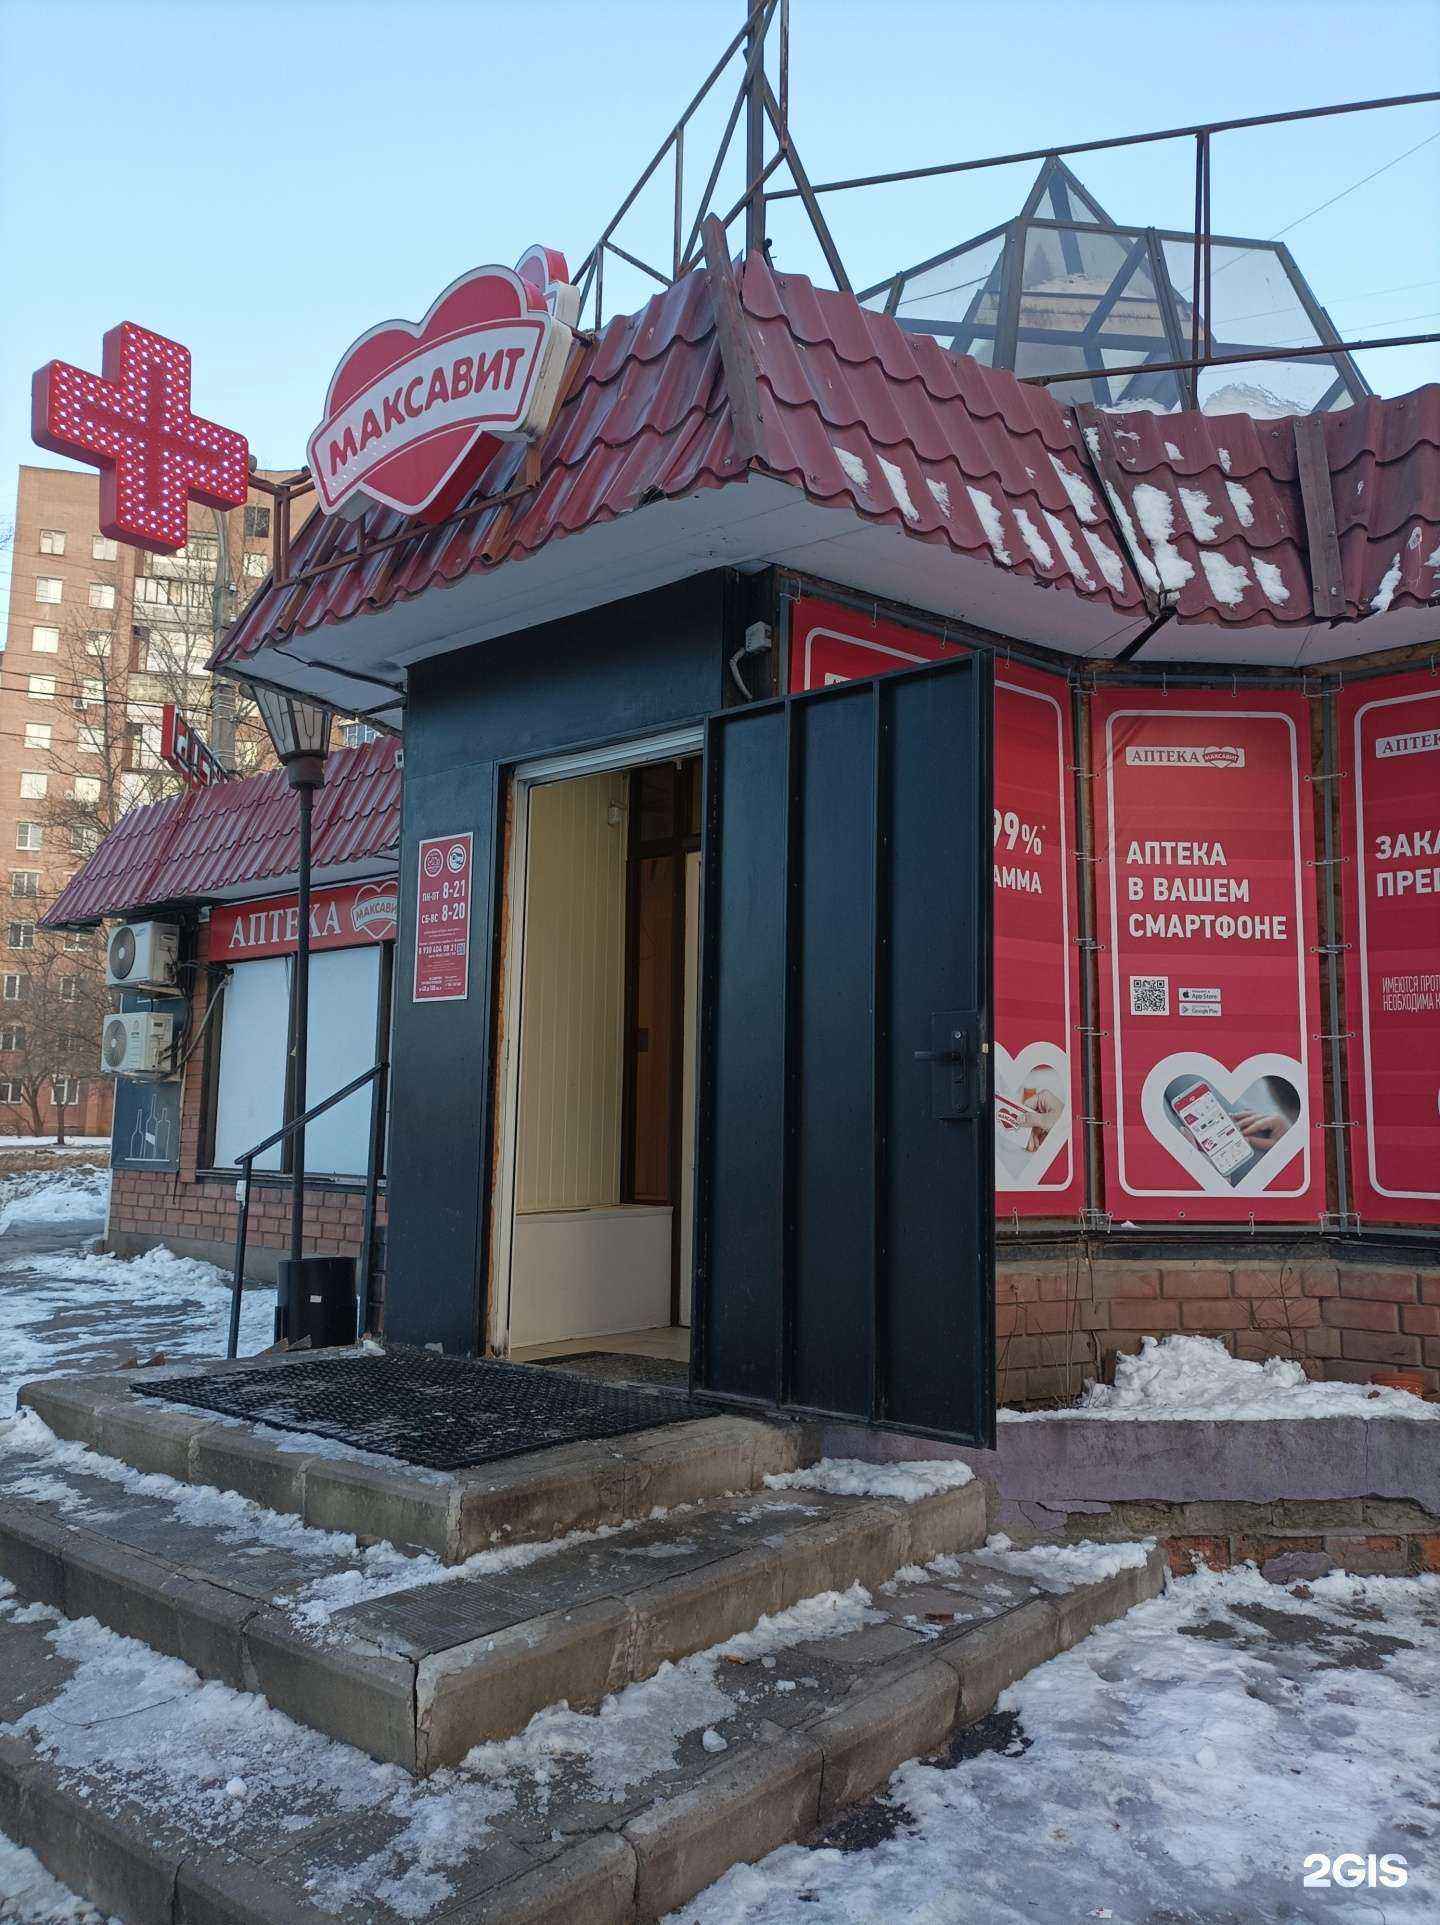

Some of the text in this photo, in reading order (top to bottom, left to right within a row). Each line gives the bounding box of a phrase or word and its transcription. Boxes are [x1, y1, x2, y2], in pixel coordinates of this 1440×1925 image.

[329, 347, 526, 477] МАКСАВИТ
[1131, 750, 1200, 763] АПТЕКА
[1126, 841, 1227, 866] АПТЕКА
[442, 880, 466, 899] 8-21
[1128, 877, 1249, 903] В ВАШЕМ
[441, 902, 466, 922] 8-20
[228, 901, 342, 949] АПТЕКА
[1129, 913, 1287, 940] СМАРТФОНЕ
[1382, 976, 1419, 993] ИМЕЮТСЯ
[1383, 993, 1434, 1013] НЕОБХОДИМА
